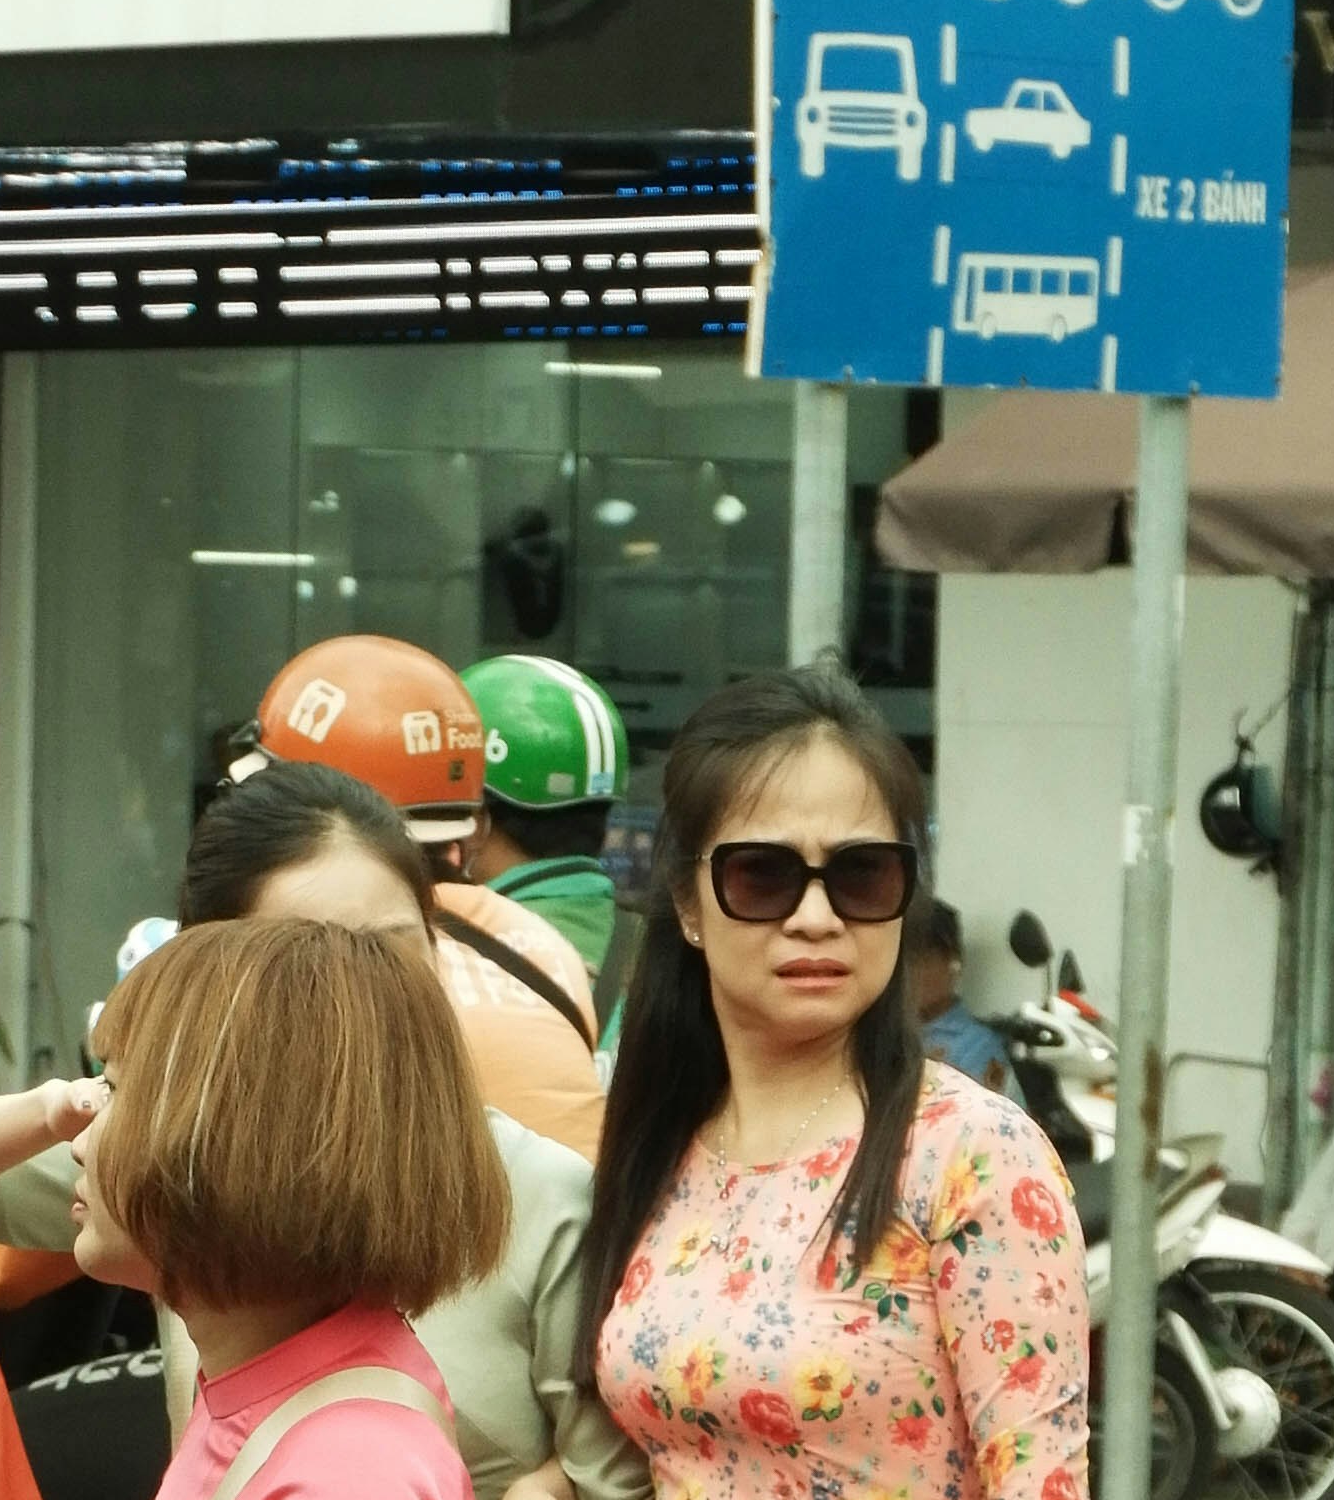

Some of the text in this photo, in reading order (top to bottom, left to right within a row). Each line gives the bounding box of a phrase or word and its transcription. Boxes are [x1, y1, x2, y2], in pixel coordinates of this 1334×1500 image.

[1136, 169, 1267, 225] XE 2 BÁNH
